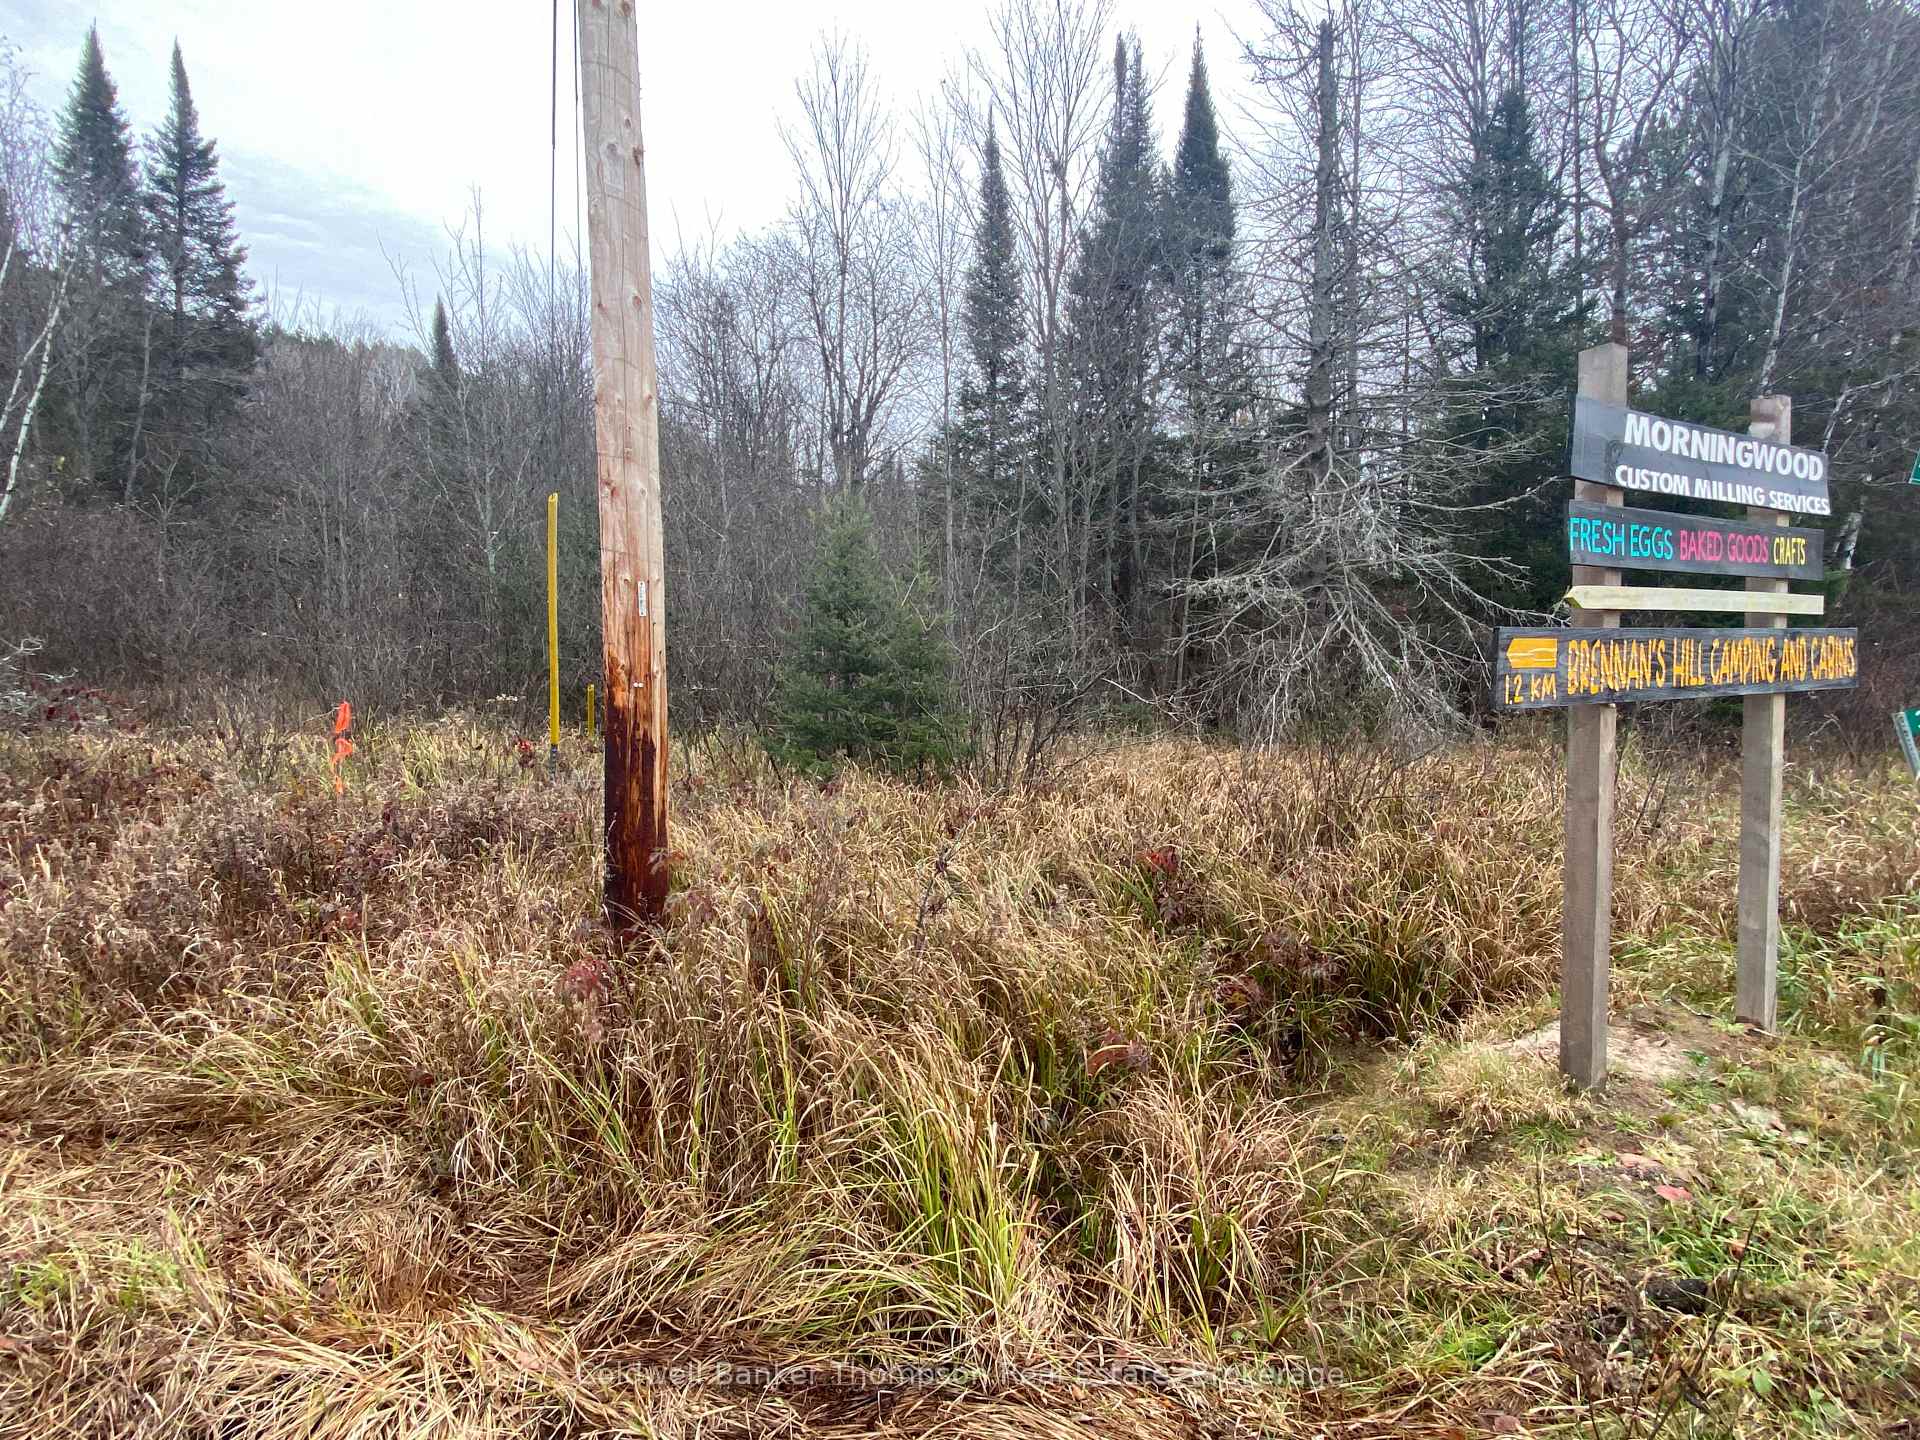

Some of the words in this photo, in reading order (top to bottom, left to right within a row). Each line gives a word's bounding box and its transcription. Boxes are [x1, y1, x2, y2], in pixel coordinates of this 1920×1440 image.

[1624, 413, 1823, 481] MORNINGWOOD
[1615, 464, 1690, 496] CUSTOM
[1694, 478, 1765, 506] MILLING
[1768, 490, 1831, 515] SERVICES
[1569, 517, 1625, 556] FRESH
[1630, 524, 1673, 560] EGGS
[1679, 528, 1723, 561] BAKED
[1728, 533, 1769, 563] GOODS
[1773, 536, 1807, 565] CRAFTS
[1567, 638, 1666, 695] BRENNAN'S
[1672, 637, 1706, 687] HILL
[1710, 636, 1777, 685] CAMPING
[1780, 634, 1807, 682] AND
[1810, 634, 1856, 680] CABINS
